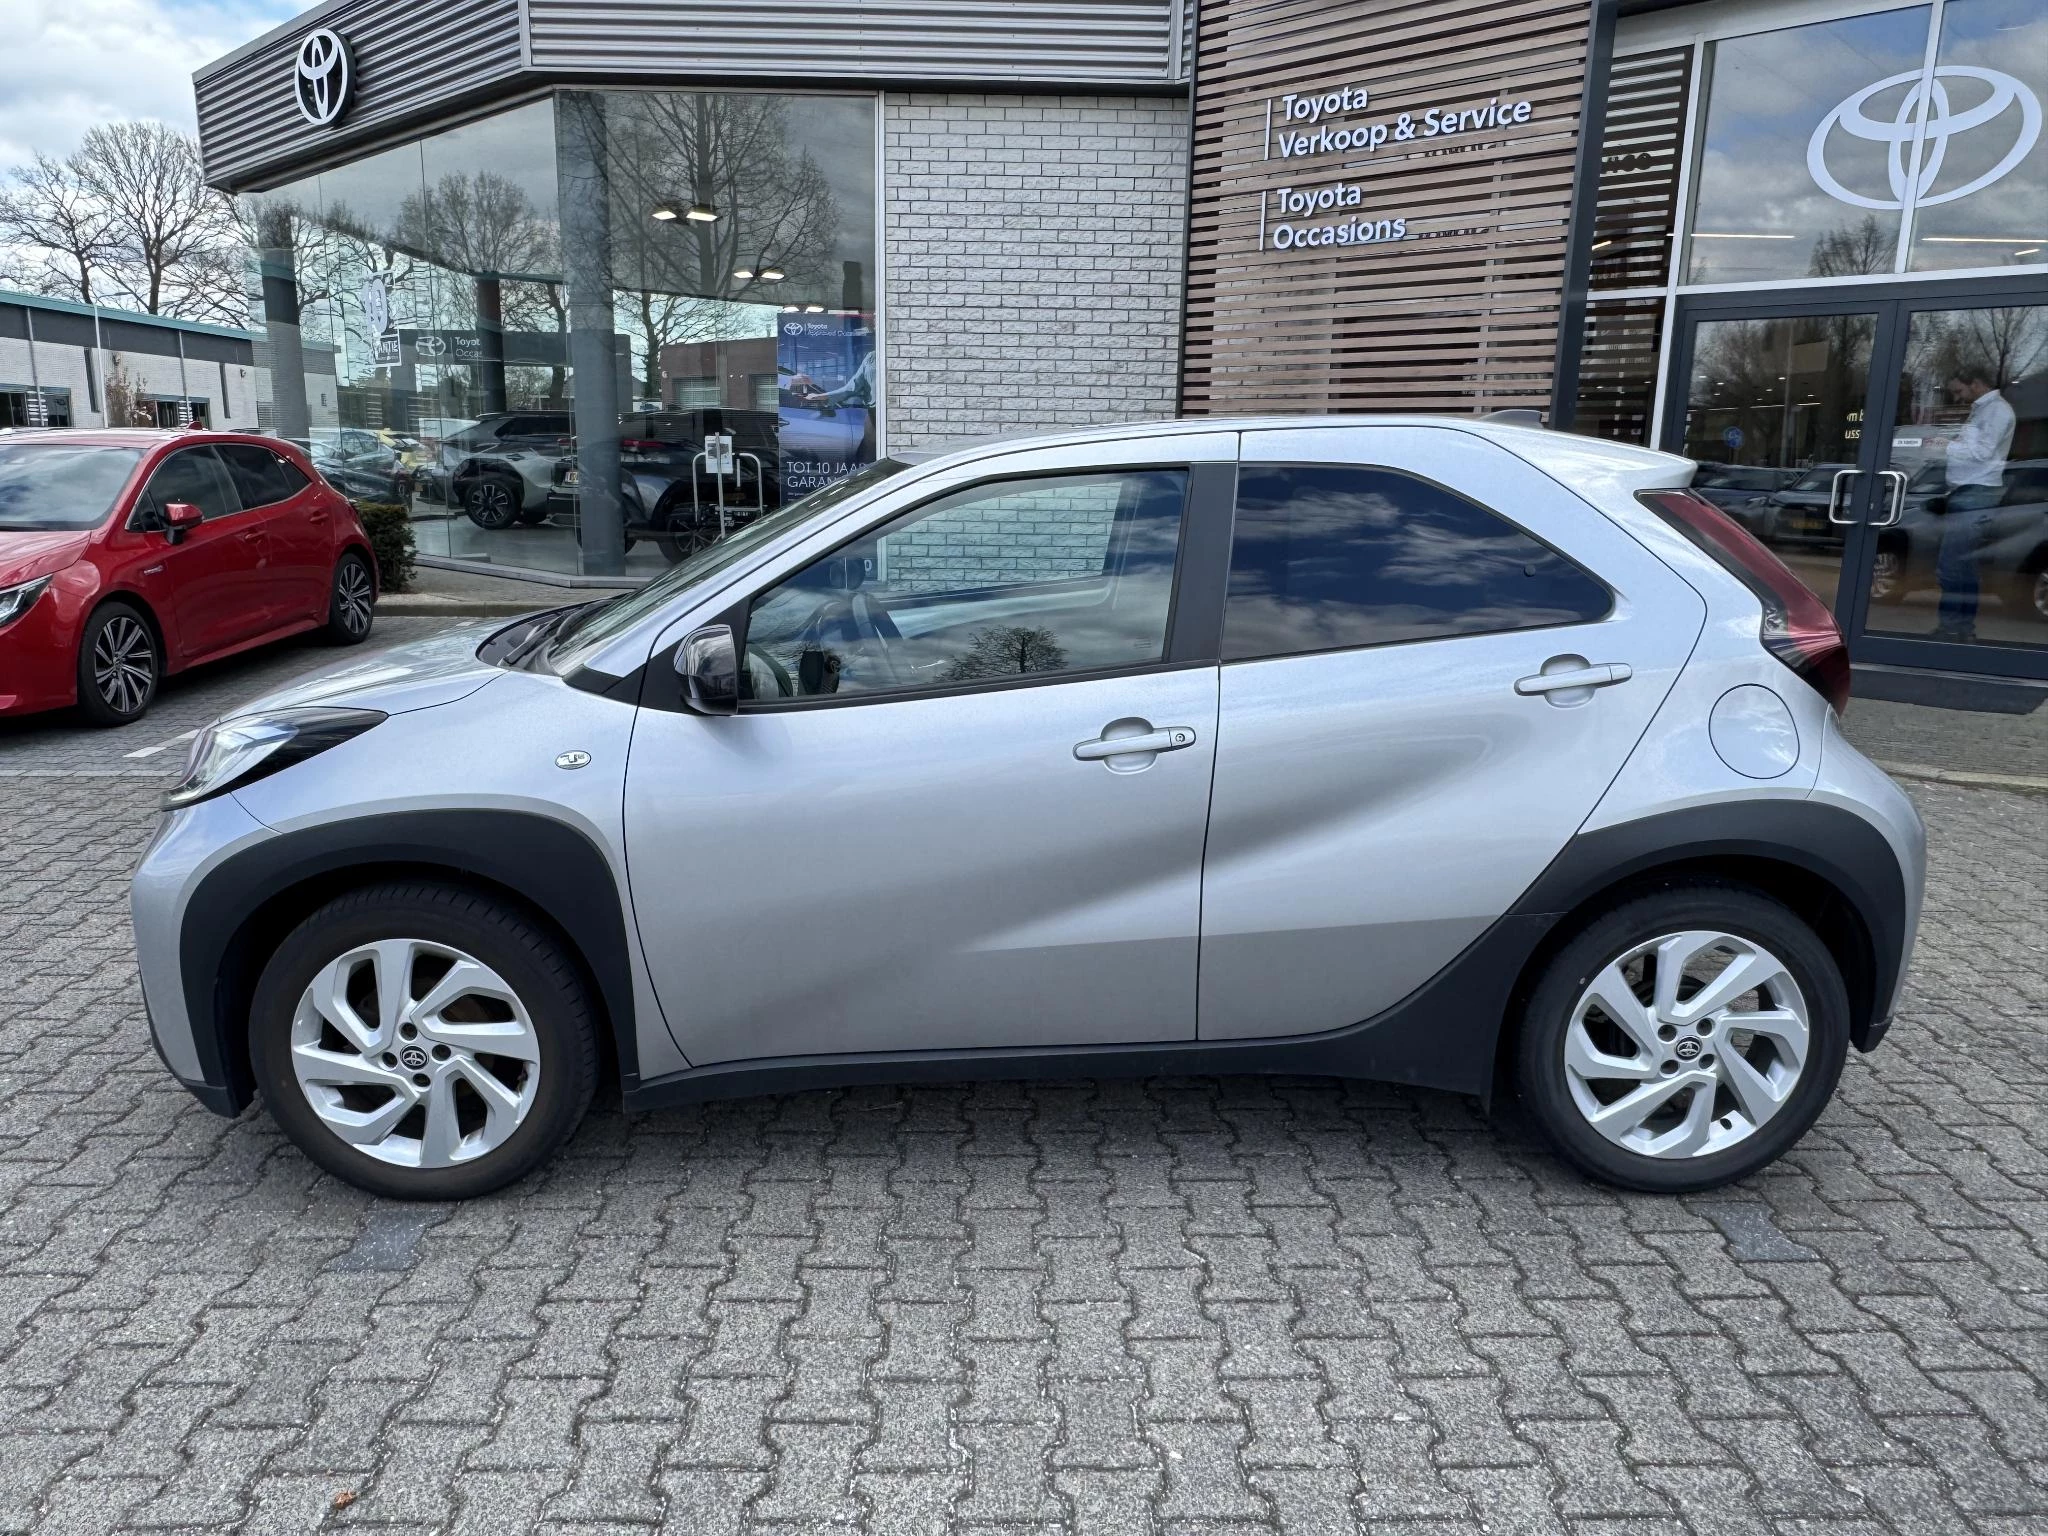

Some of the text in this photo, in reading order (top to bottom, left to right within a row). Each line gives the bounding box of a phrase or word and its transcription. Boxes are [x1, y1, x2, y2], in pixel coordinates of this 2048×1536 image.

[1282, 86, 1368, 123] Toyota
[1279, 97, 1532, 158] Verkoop & Service
[1277, 182, 1362, 217] Toyota
[1273, 216, 1406, 250] Occasions
[786, 461, 812, 474] TOT
[816, 462, 830, 474] 10
